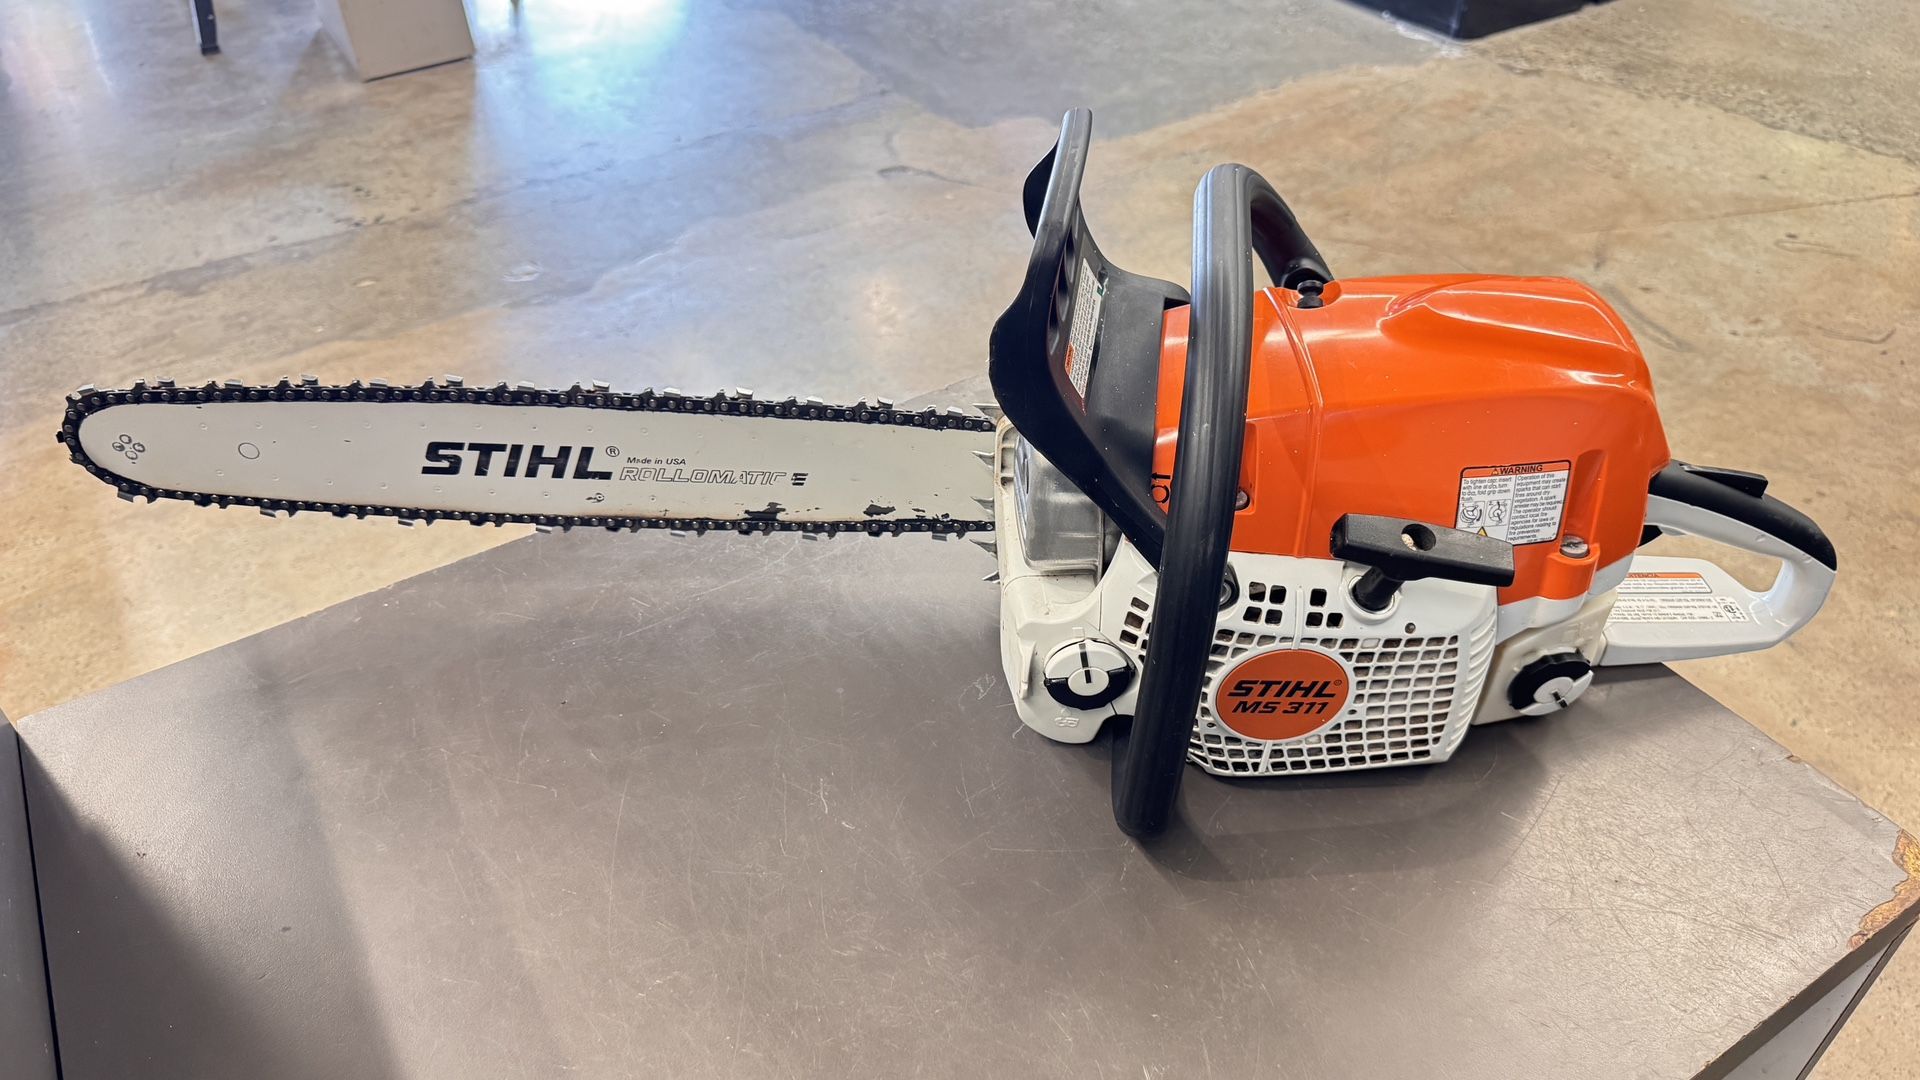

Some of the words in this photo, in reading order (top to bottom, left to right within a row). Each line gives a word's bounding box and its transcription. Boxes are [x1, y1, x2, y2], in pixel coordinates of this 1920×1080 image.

[666, 458, 686, 466] USA
[1500, 465, 1543, 474] WARNING
[1232, 700, 1281, 713] MS
[1282, 701, 1329, 714] 311
